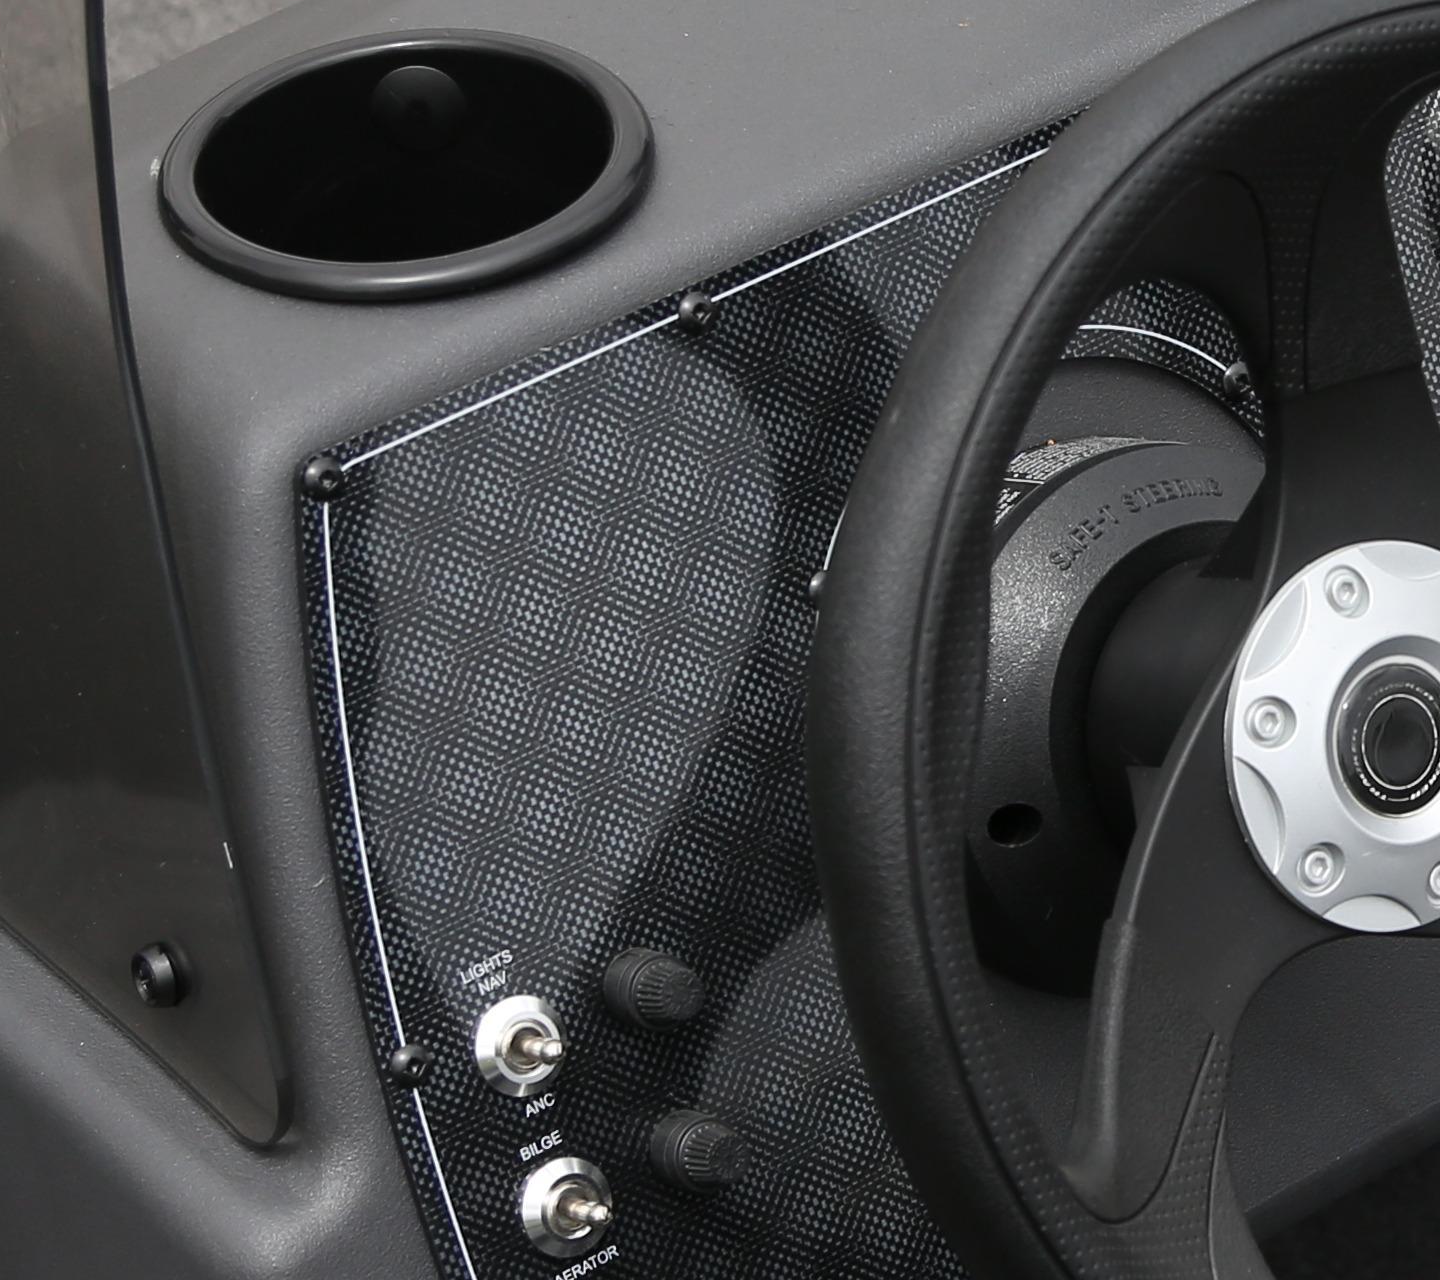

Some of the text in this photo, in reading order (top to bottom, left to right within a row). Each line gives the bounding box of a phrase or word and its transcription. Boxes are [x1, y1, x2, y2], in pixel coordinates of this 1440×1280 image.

[1048, 504, 1120, 571] SAFE-T
[1121, 477, 1223, 513] STEERING
[460, 949, 513, 985] LIGHTS
[477, 970, 507, 996] NAV
[525, 1092, 556, 1117] ANC
[519, 1129, 563, 1162] BILGE
